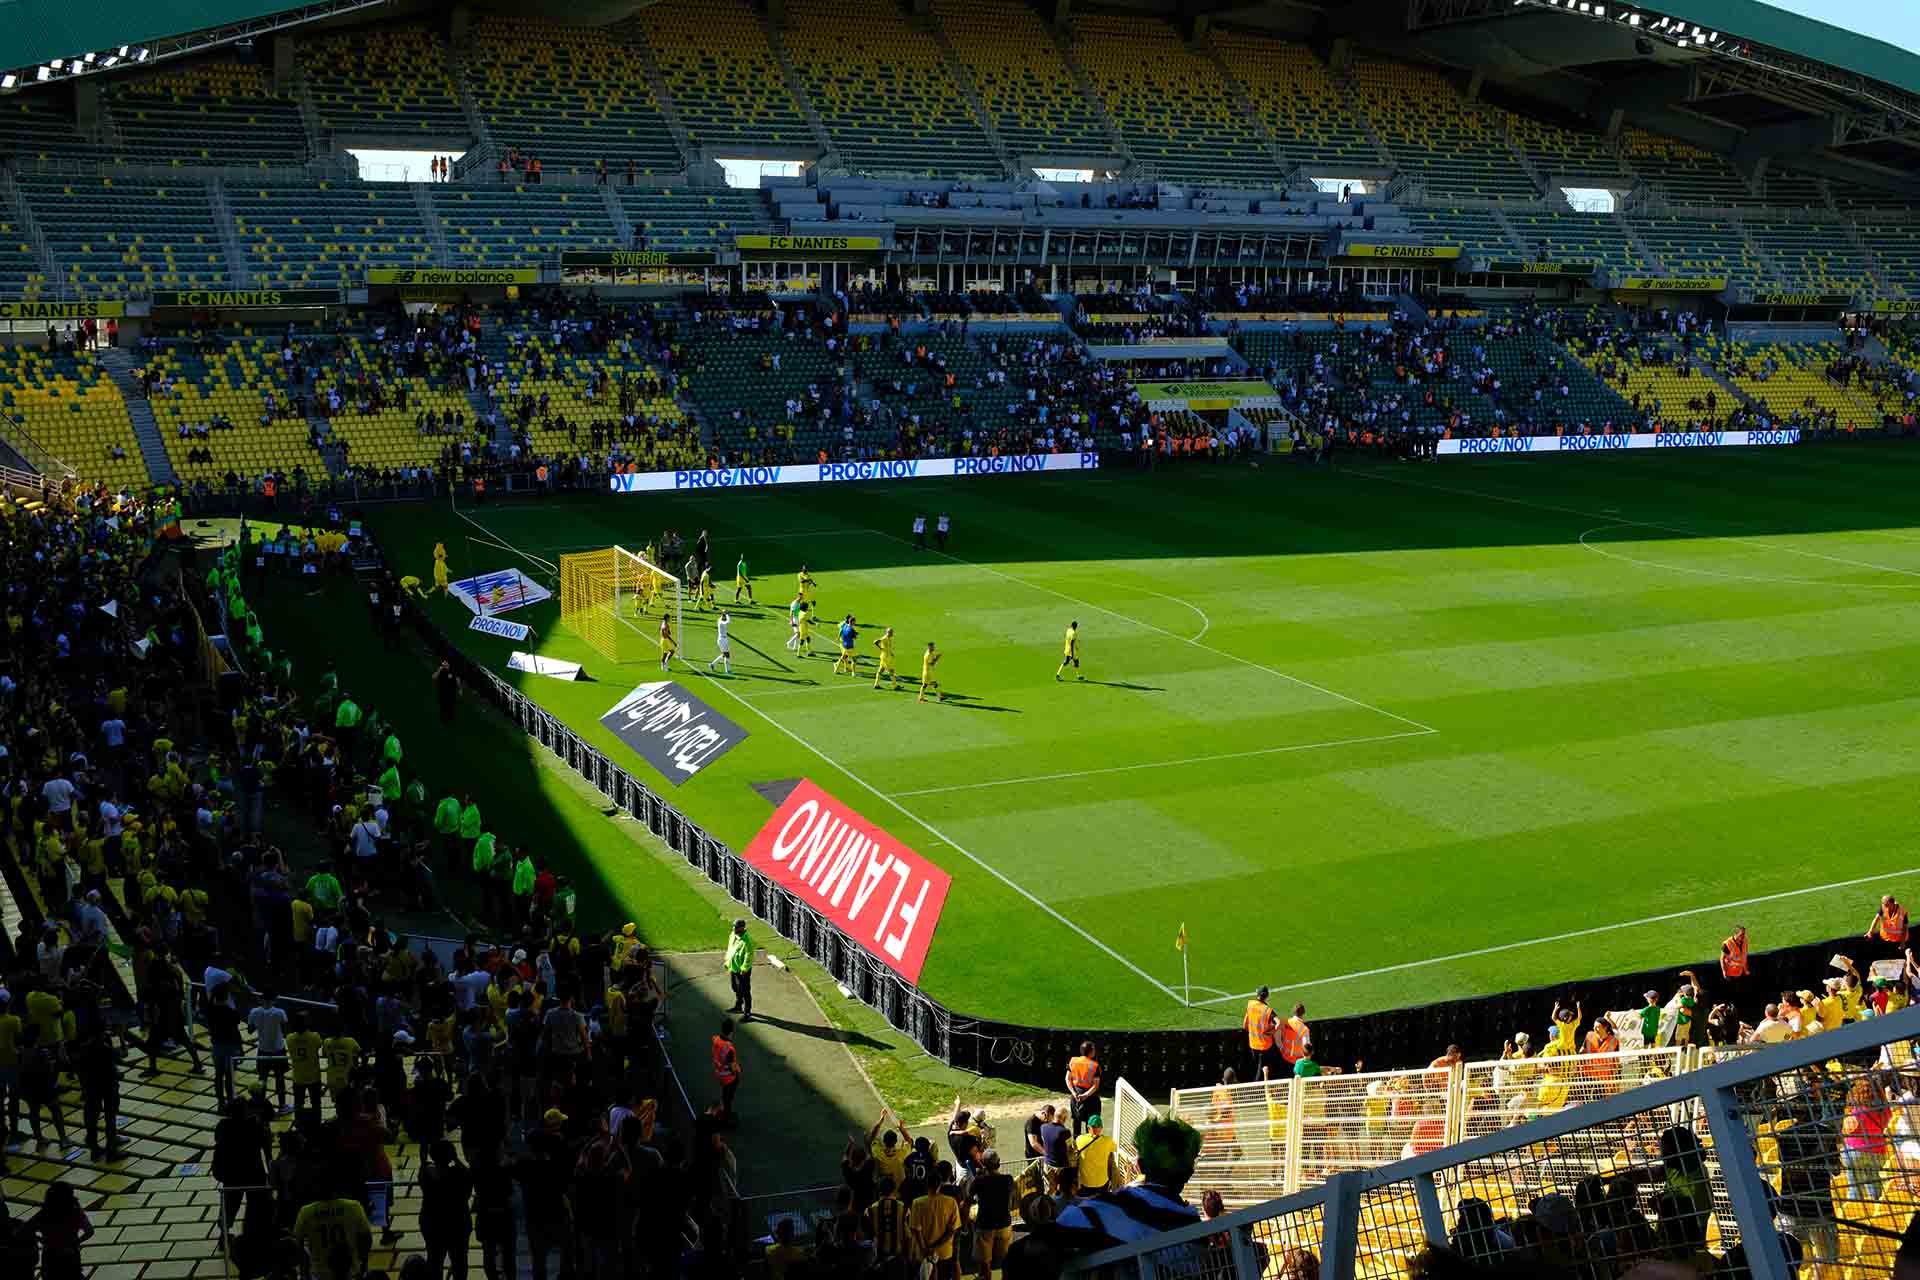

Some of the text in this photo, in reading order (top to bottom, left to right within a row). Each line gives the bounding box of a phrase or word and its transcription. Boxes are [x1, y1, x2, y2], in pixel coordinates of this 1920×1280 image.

[770, 237, 848, 249] FC NANTES
[611, 252, 669, 265] SYNERGIE
[1374, 247, 1435, 257] FC NANTES
[422, 271, 515, 283] new balance
[178, 292, 282, 305] FC NANTES
[1888, 302, 1903, 310] FC
[20, 303, 98, 317] NANTES
[1459, 437, 1534, 453] PROG/NOV
[1559, 434, 1631, 450] PROG/NOV
[1656, 432, 1724, 447] PROG/NOV
[818, 459, 918, 481] PROG/NOV
[953, 454, 1048, 475] PROG/NOV
[675, 466, 782, 489] PROG/NOV
[473, 617, 526, 638] PROG/NOV
[772, 799, 931, 962] FLAMINO
